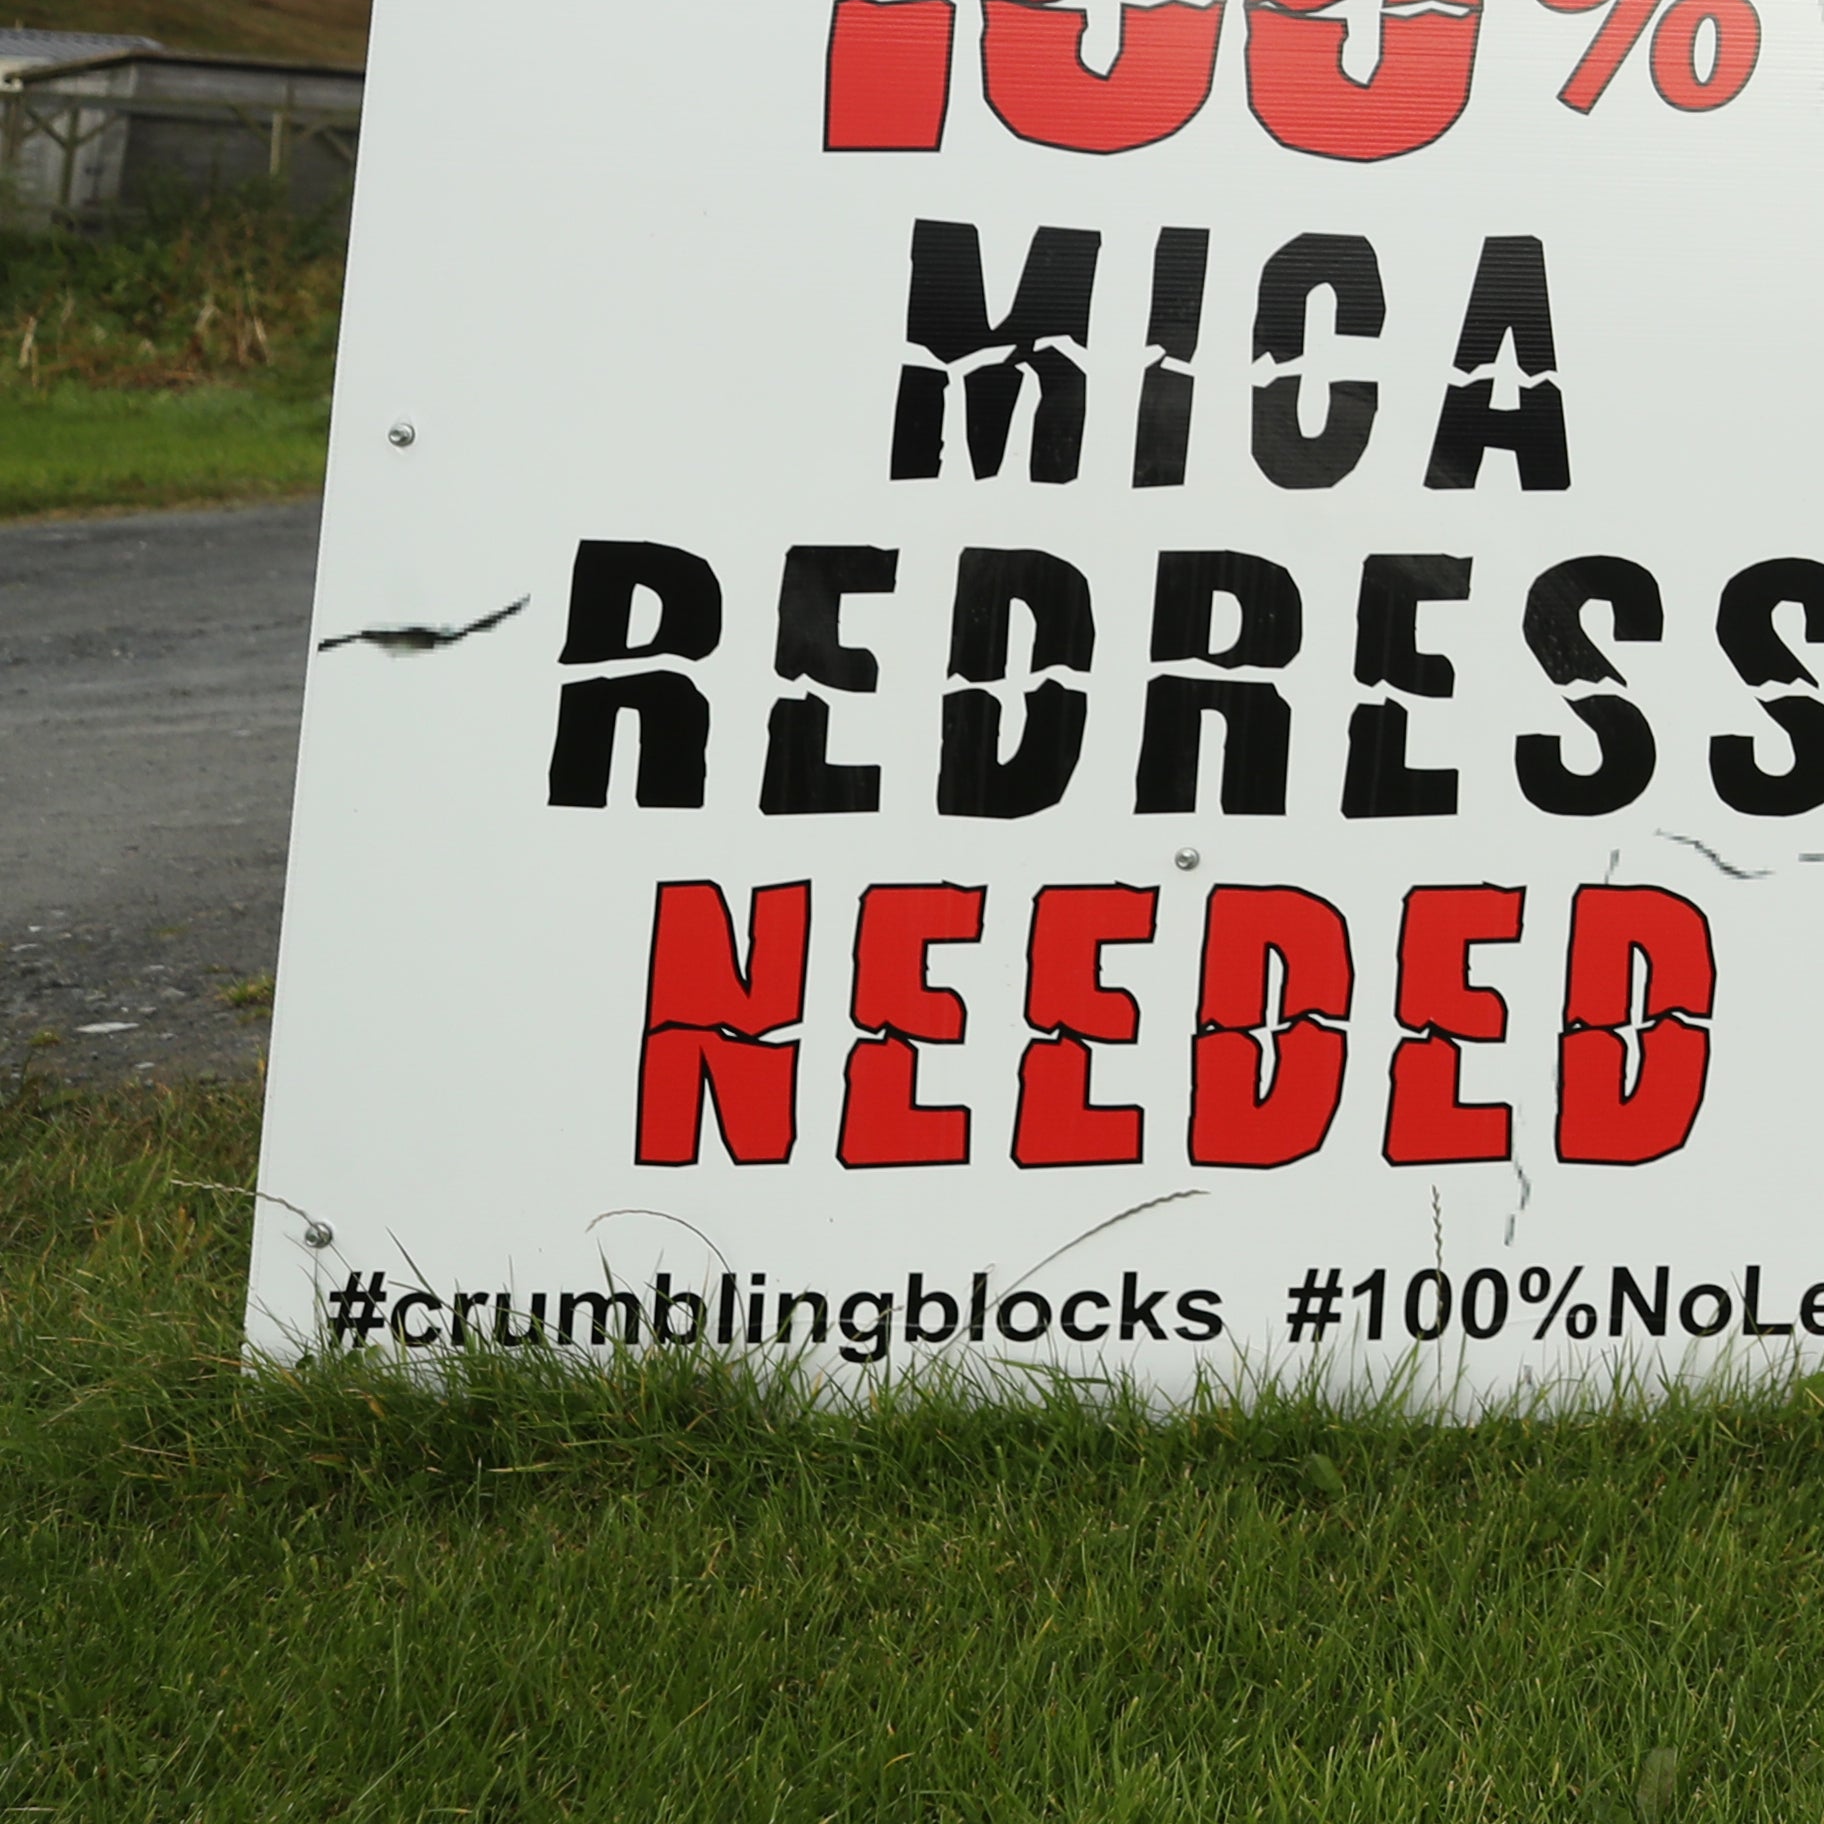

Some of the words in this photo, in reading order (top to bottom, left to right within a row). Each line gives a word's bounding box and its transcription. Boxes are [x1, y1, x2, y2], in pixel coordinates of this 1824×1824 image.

[888, 219, 1573, 492] MICA
[634, 879, 1718, 1170] NEEDED
[328, 1269, 1225, 1363] #crumblingblocks
